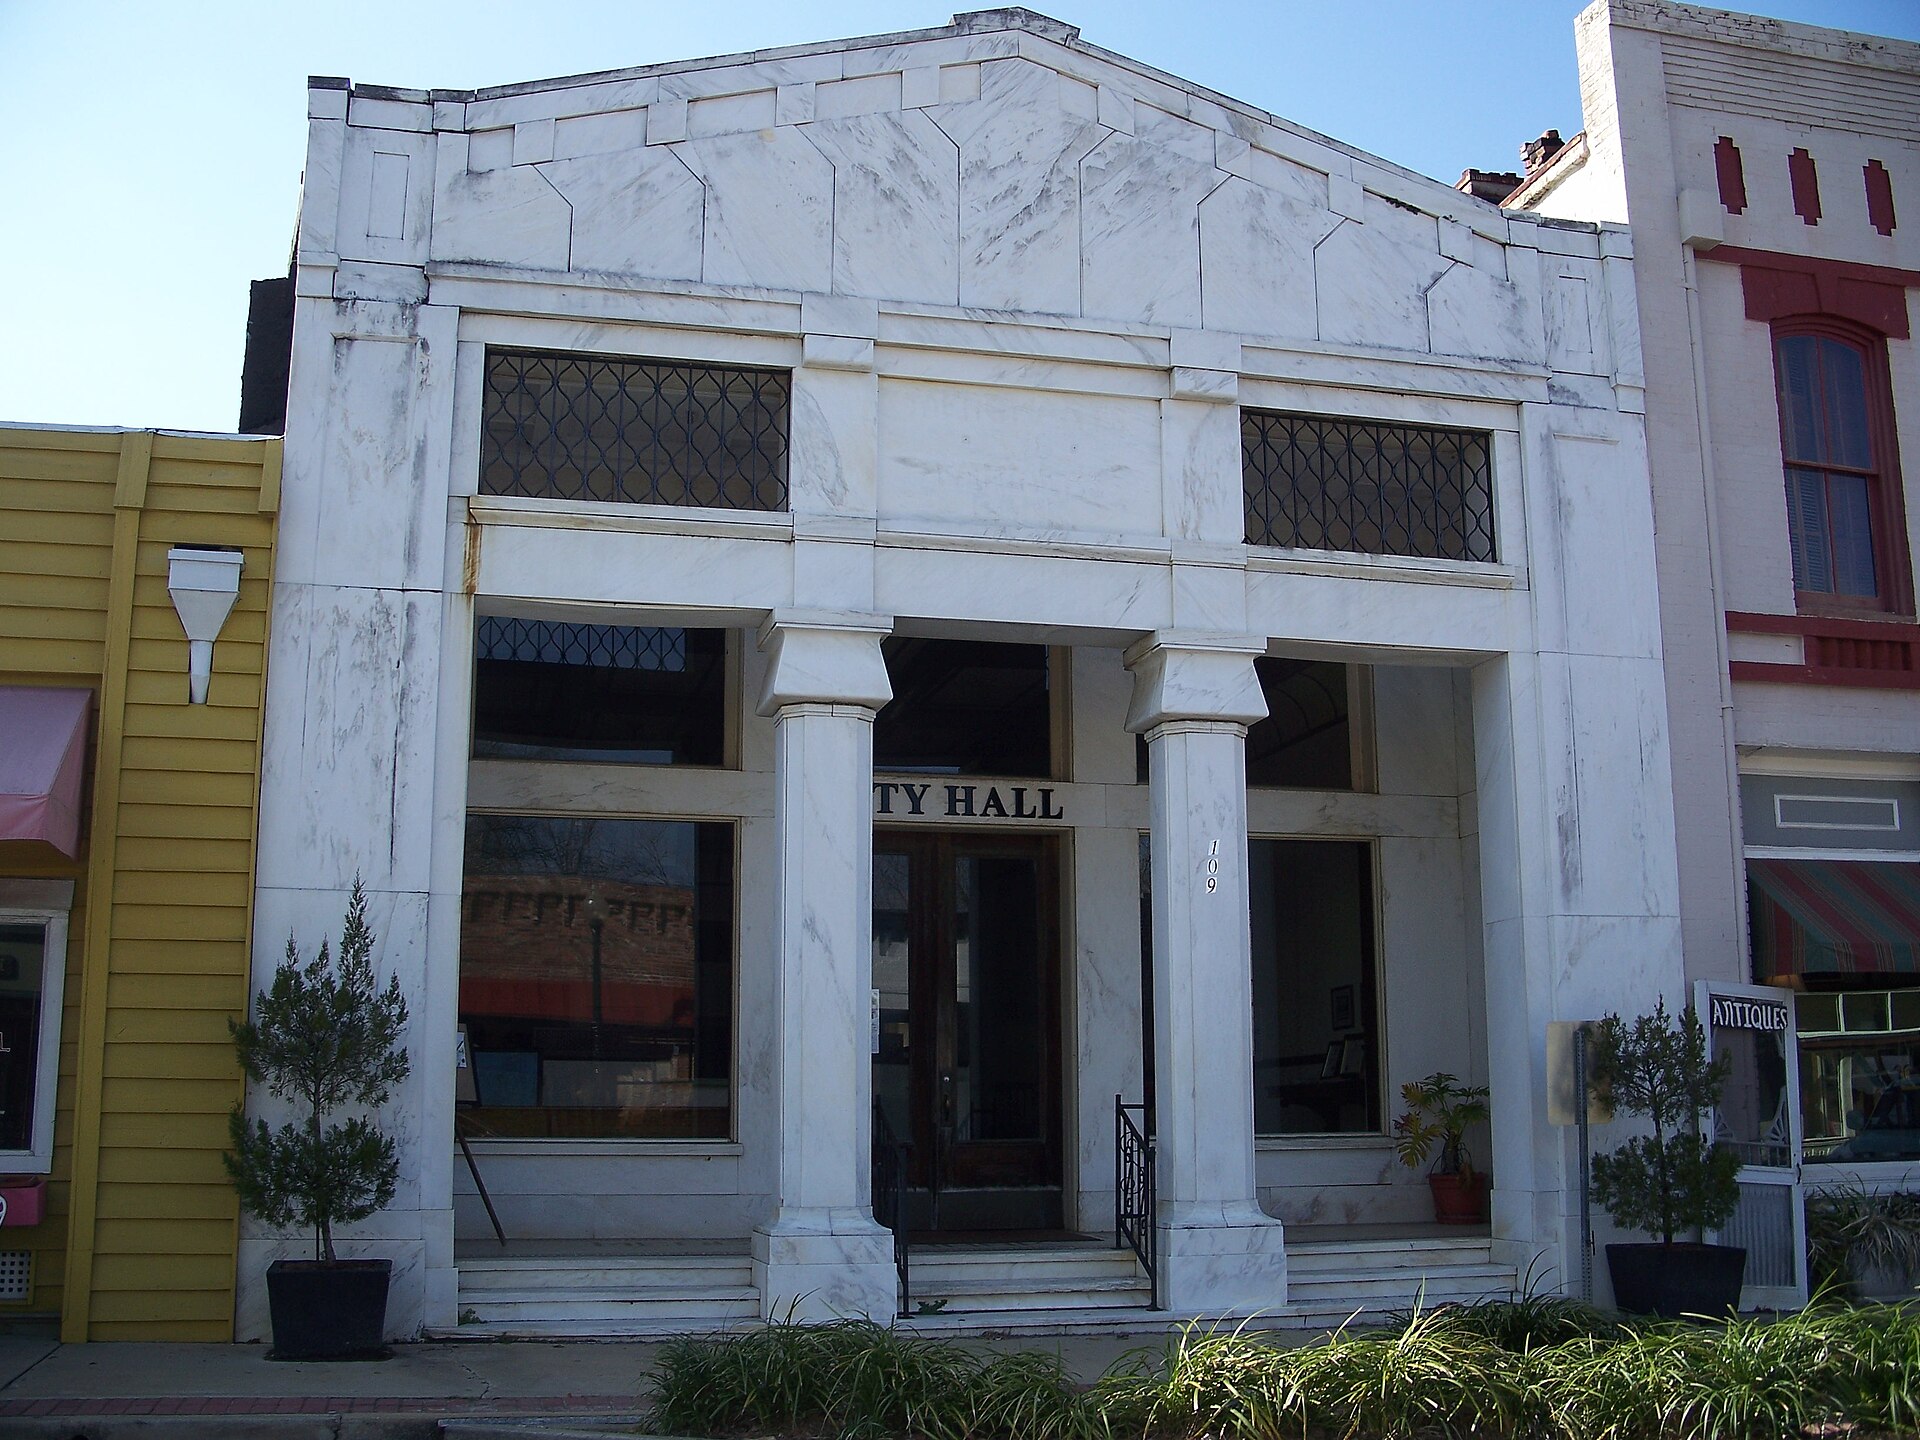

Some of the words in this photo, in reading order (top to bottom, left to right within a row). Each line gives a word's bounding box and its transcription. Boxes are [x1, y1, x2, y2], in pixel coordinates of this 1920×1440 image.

[873, 782, 931, 815] TY
[944, 785, 1064, 820] HALL
[1207, 840, 1218, 894] 109
[1712, 999, 1788, 1031] ANTIQUES
